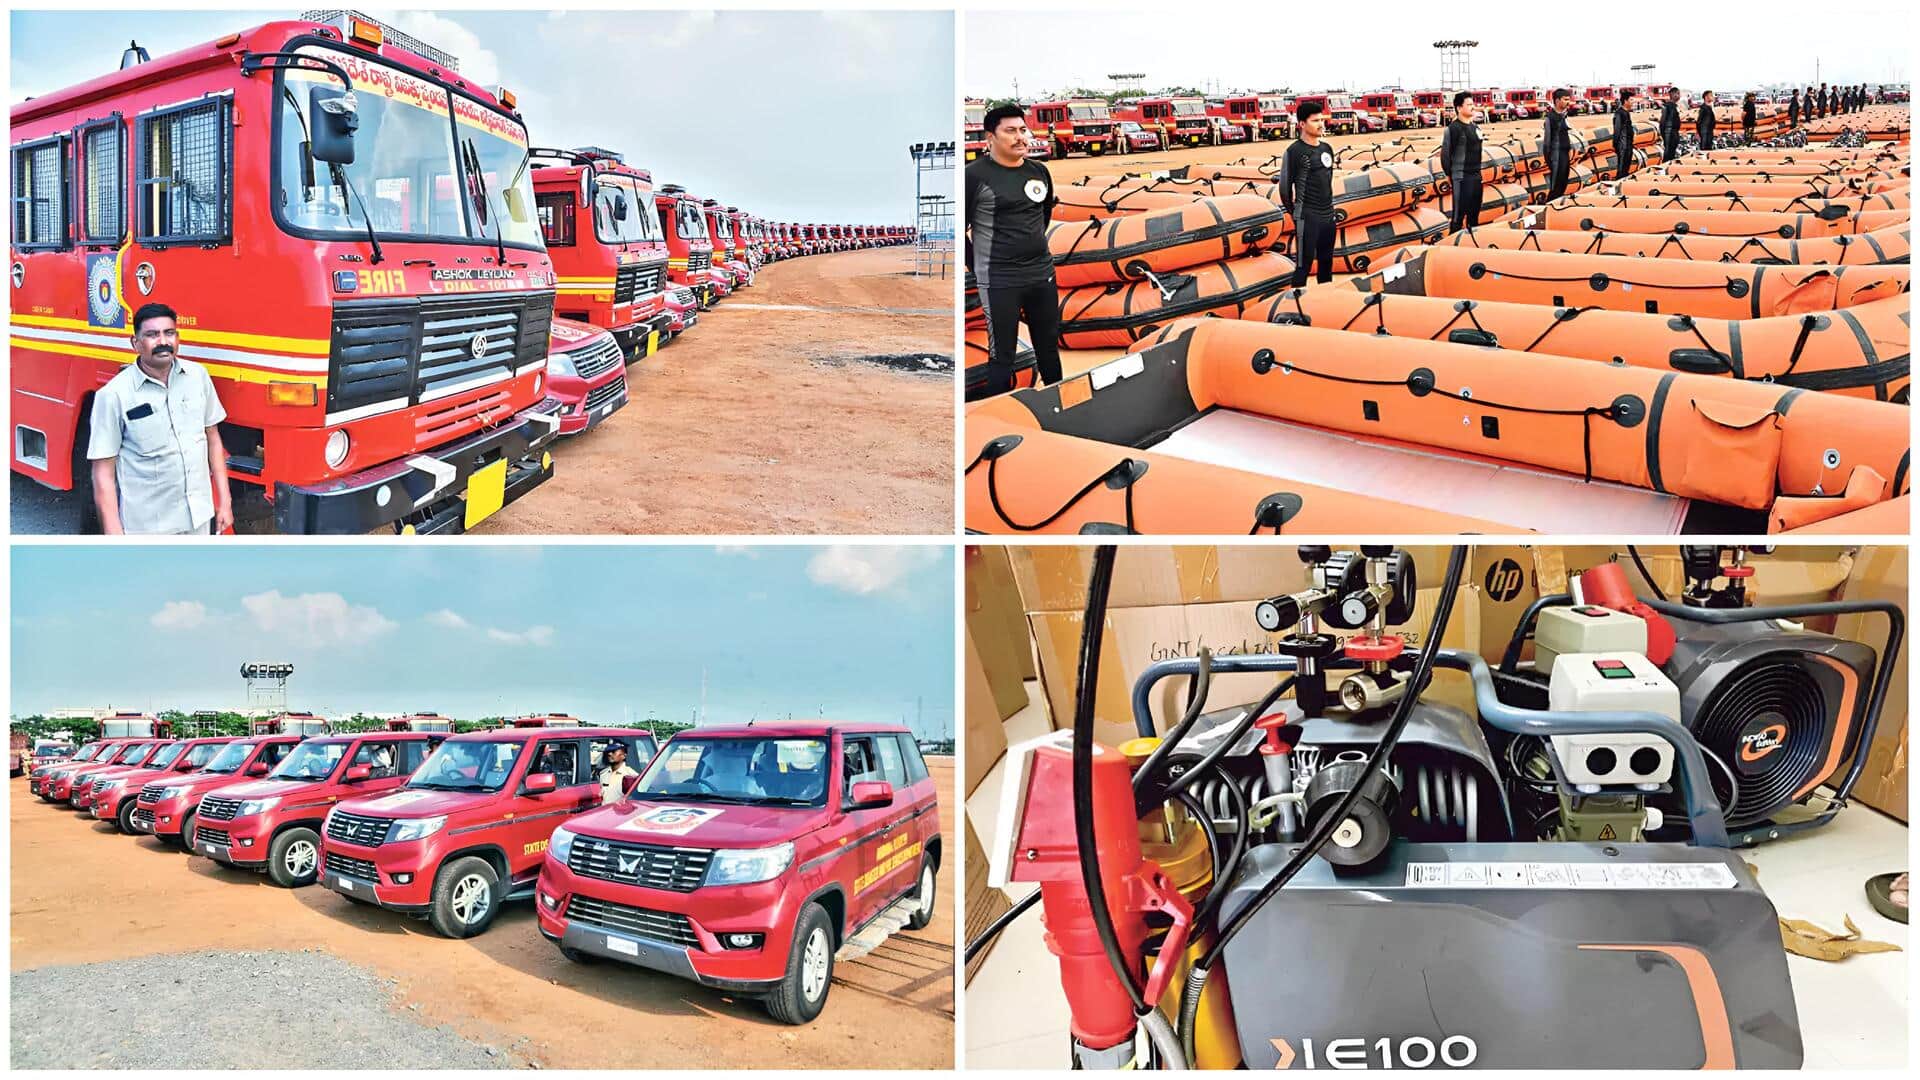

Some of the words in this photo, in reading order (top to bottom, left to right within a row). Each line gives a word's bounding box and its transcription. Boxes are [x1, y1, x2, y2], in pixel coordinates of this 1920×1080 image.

[435, 269, 472, 280] ASHOK
[477, 268, 516, 279] LEYLAND
[444, 281, 477, 292] DIAL
[1488, 558, 1521, 601] hp
[1302, 1035, 1478, 1069] IE100
